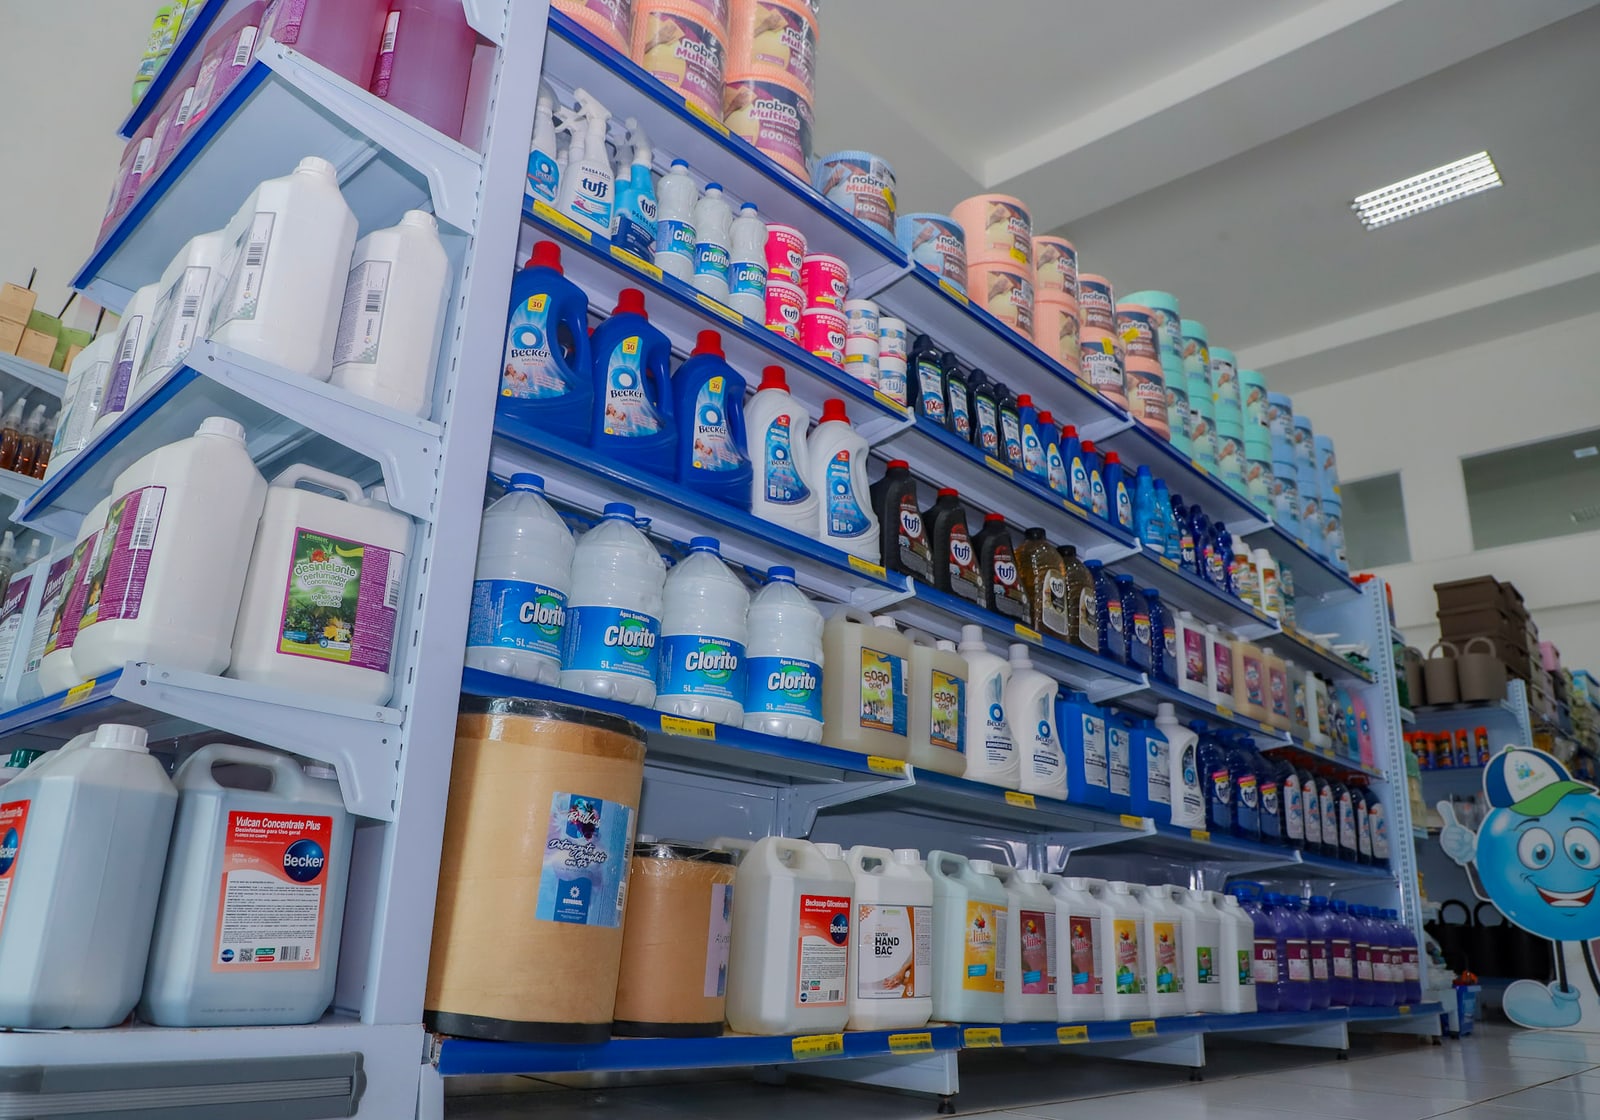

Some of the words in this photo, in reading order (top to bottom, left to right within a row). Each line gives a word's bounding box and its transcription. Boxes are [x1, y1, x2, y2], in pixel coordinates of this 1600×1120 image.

[684, 40, 718, 67] nobre
[756, 99, 796, 117] nobre
[750, 109, 799, 129] Multisec
[760, 129, 783, 142] 600
[582, 178, 609, 198] tuff
[640, 199, 657, 218] tuff
[856, 202, 876, 213] 600
[784, 308, 798, 321] tuff
[511, 348, 550, 359] Becker
[610, 389, 644, 398] Becker
[698, 425, 727, 435] Becker
[903, 513, 920, 532] tuff
[953, 543, 970, 559] tuff
[295, 560, 356, 577] desinfetante
[997, 565, 1015, 581] tuff
[303, 571, 347, 583] perfumador
[307, 579, 344, 588] concentrado
[520, 601, 566, 627] Clorito
[516, 637, 525, 647] 5L
[604, 625, 655, 648] Clorito
[601, 660, 610, 669] 5L
[685, 651, 738, 671] Clorito
[768, 672, 816, 691] Clorito
[864, 670, 890, 686] soap
[683, 685, 692, 693] 5L
[869, 681, 882, 690] gold
[934, 692, 957, 706] soap
[766, 702, 774, 711] 5L
[236, 816, 260, 827] Vulcan
[262, 818, 304, 829] Concentrate
[305, 820, 321, 831] Plus
[283, 853, 324, 867] Becker
[830, 923, 848, 934] Becker
[875, 936, 900, 946] HAND
[875, 946, 893, 955] BAC
